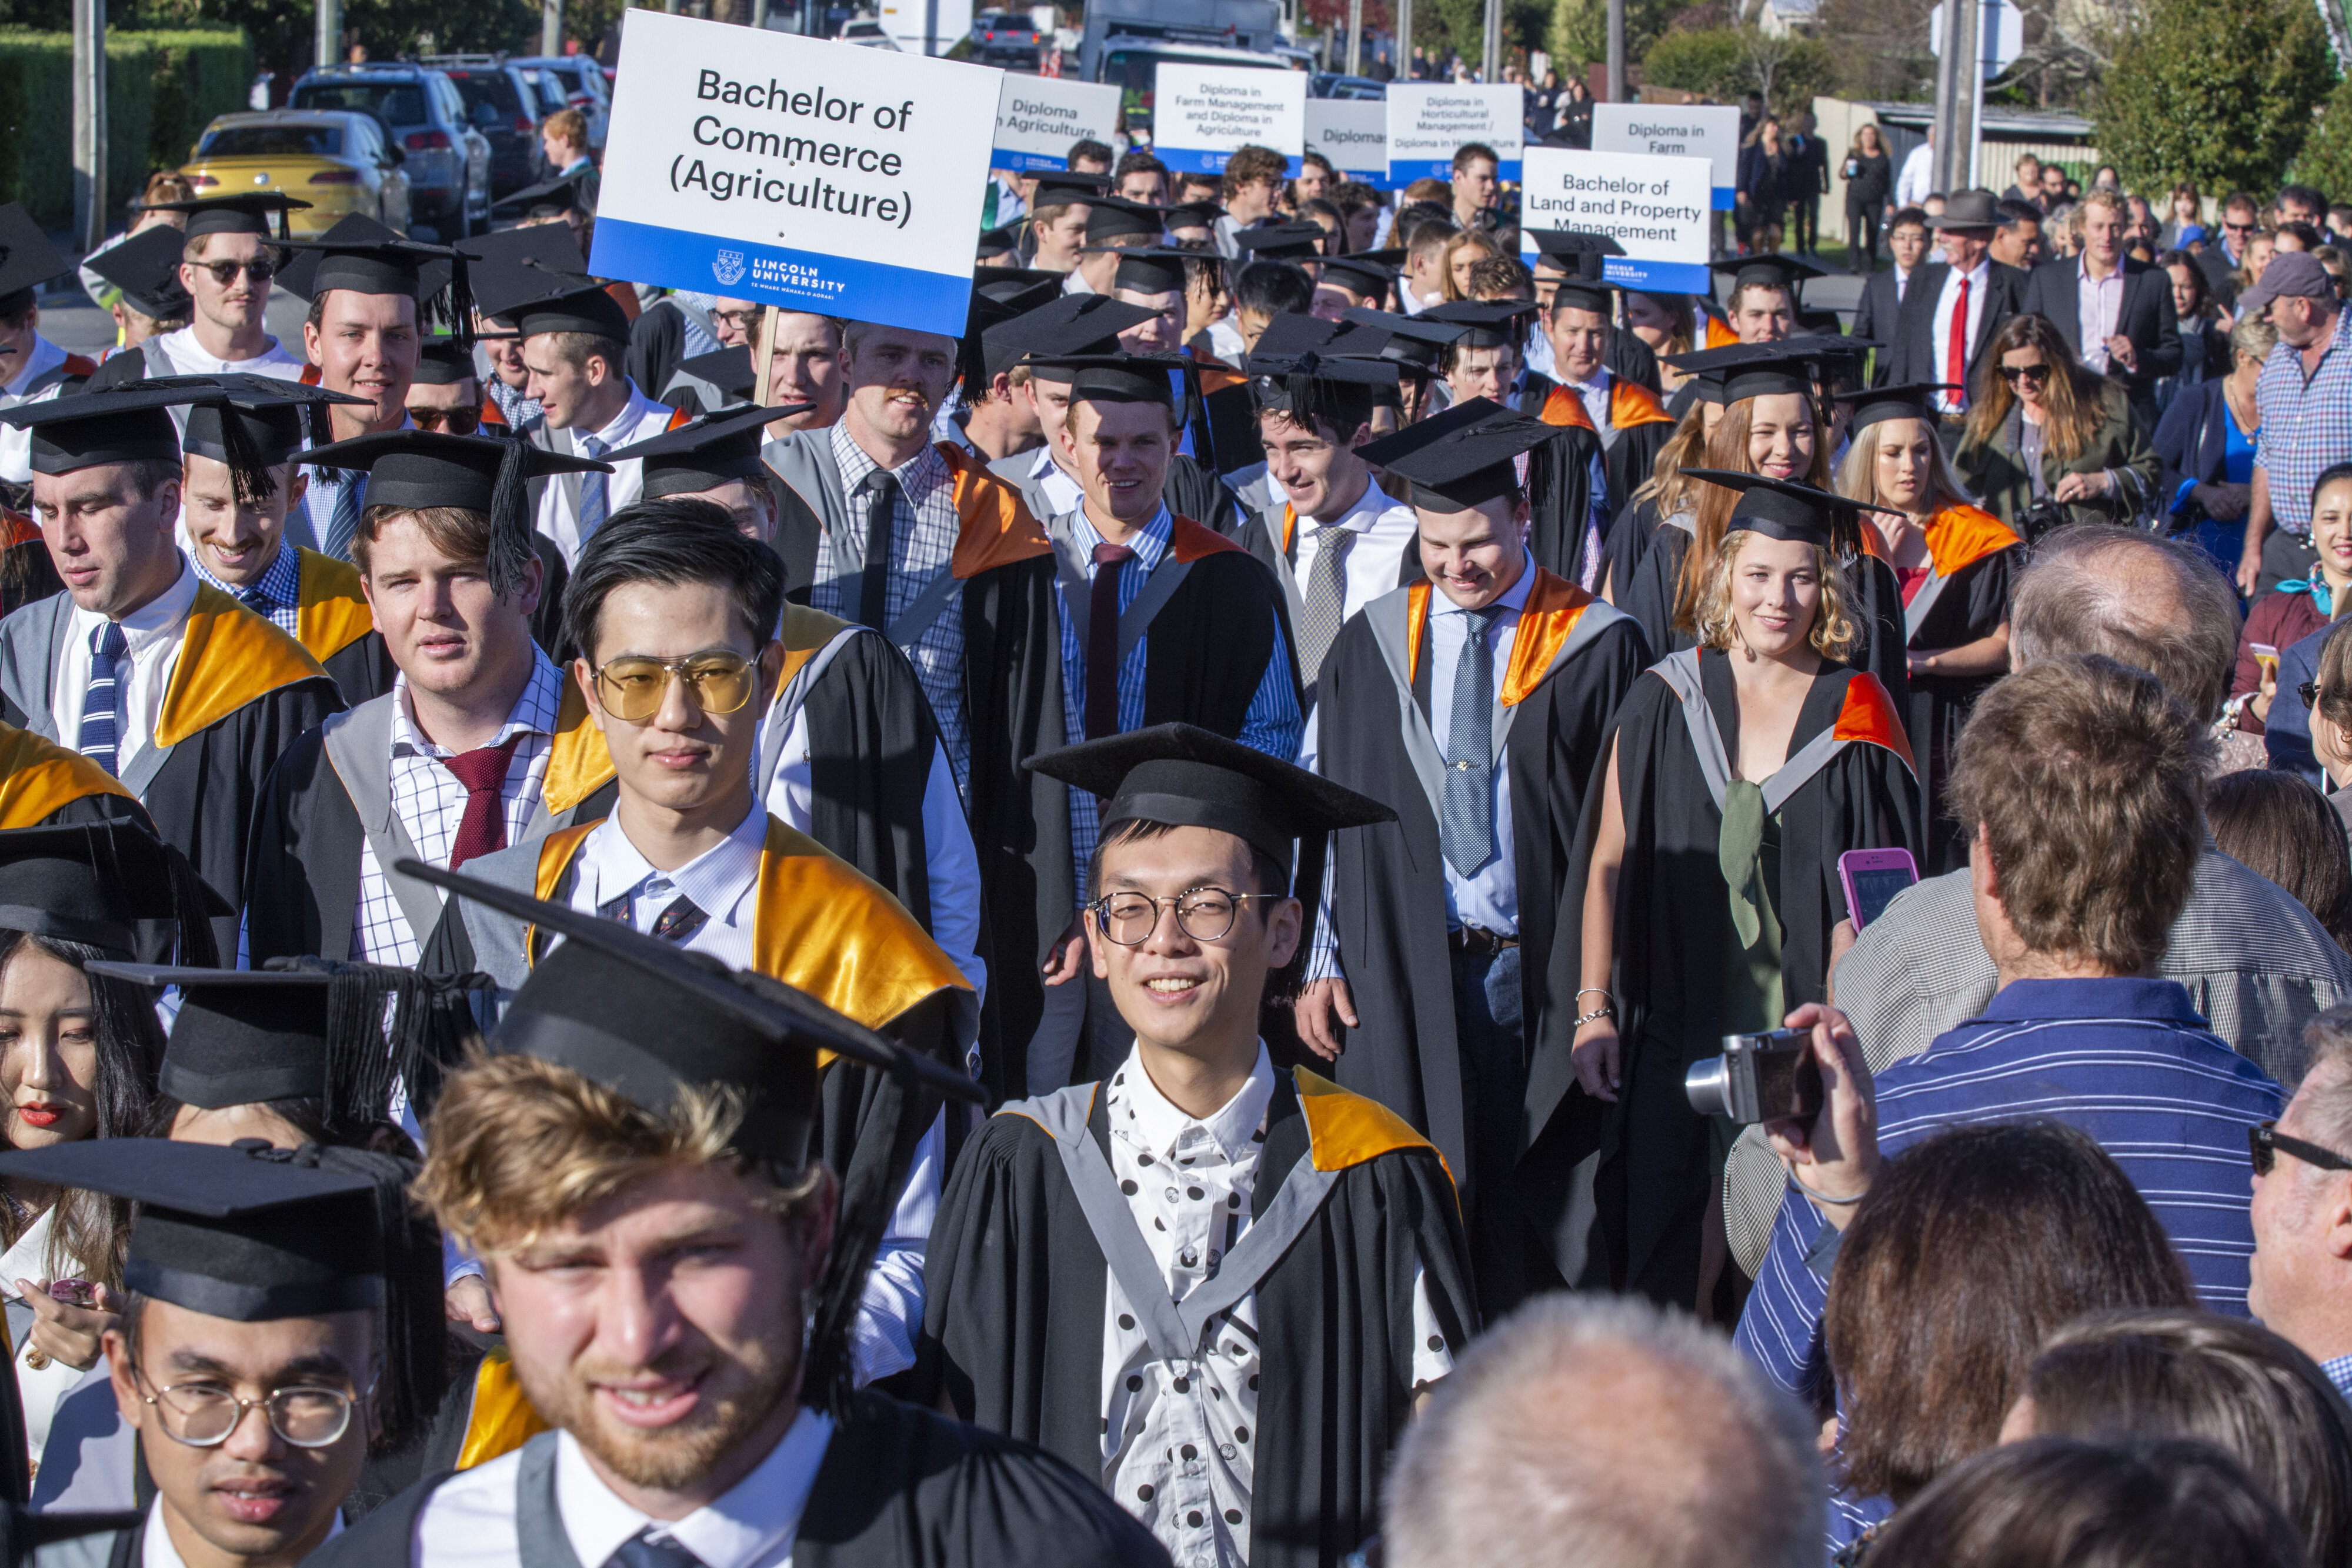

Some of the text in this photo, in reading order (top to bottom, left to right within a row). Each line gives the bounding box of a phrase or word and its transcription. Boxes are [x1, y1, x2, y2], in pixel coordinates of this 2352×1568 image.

[1200, 84, 1262, 96] Diploma in
[697, 68, 914, 132] Bachelor of
[1176, 95, 1285, 111] Farm Management
[1427, 97, 1484, 108] Diploma in
[1012, 99, 1077, 119] Diploma
[1421, 109, 1489, 118] Horticultural
[1186, 111, 1272, 124] and Diploma in
[996, 116, 1096, 138] n Agriculture
[1196, 124, 1261, 137] Agriculture
[1417, 122, 1486, 132] Management
[1628, 123, 1704, 139] Diploma in
[693, 115, 902, 176] Commerce
[1394, 138, 1437, 148] Diploma
[1440, 138, 1450, 147] in
[1649, 140, 1686, 154] Farm
[670, 154, 912, 229] (Agriculture)
[1563, 174, 1670, 196] Bachelor of
[1530, 195, 1702, 223] Land and Property
[753, 258, 818, 277] LINCOLN
[752, 269, 846, 292] UNIVERSITY
